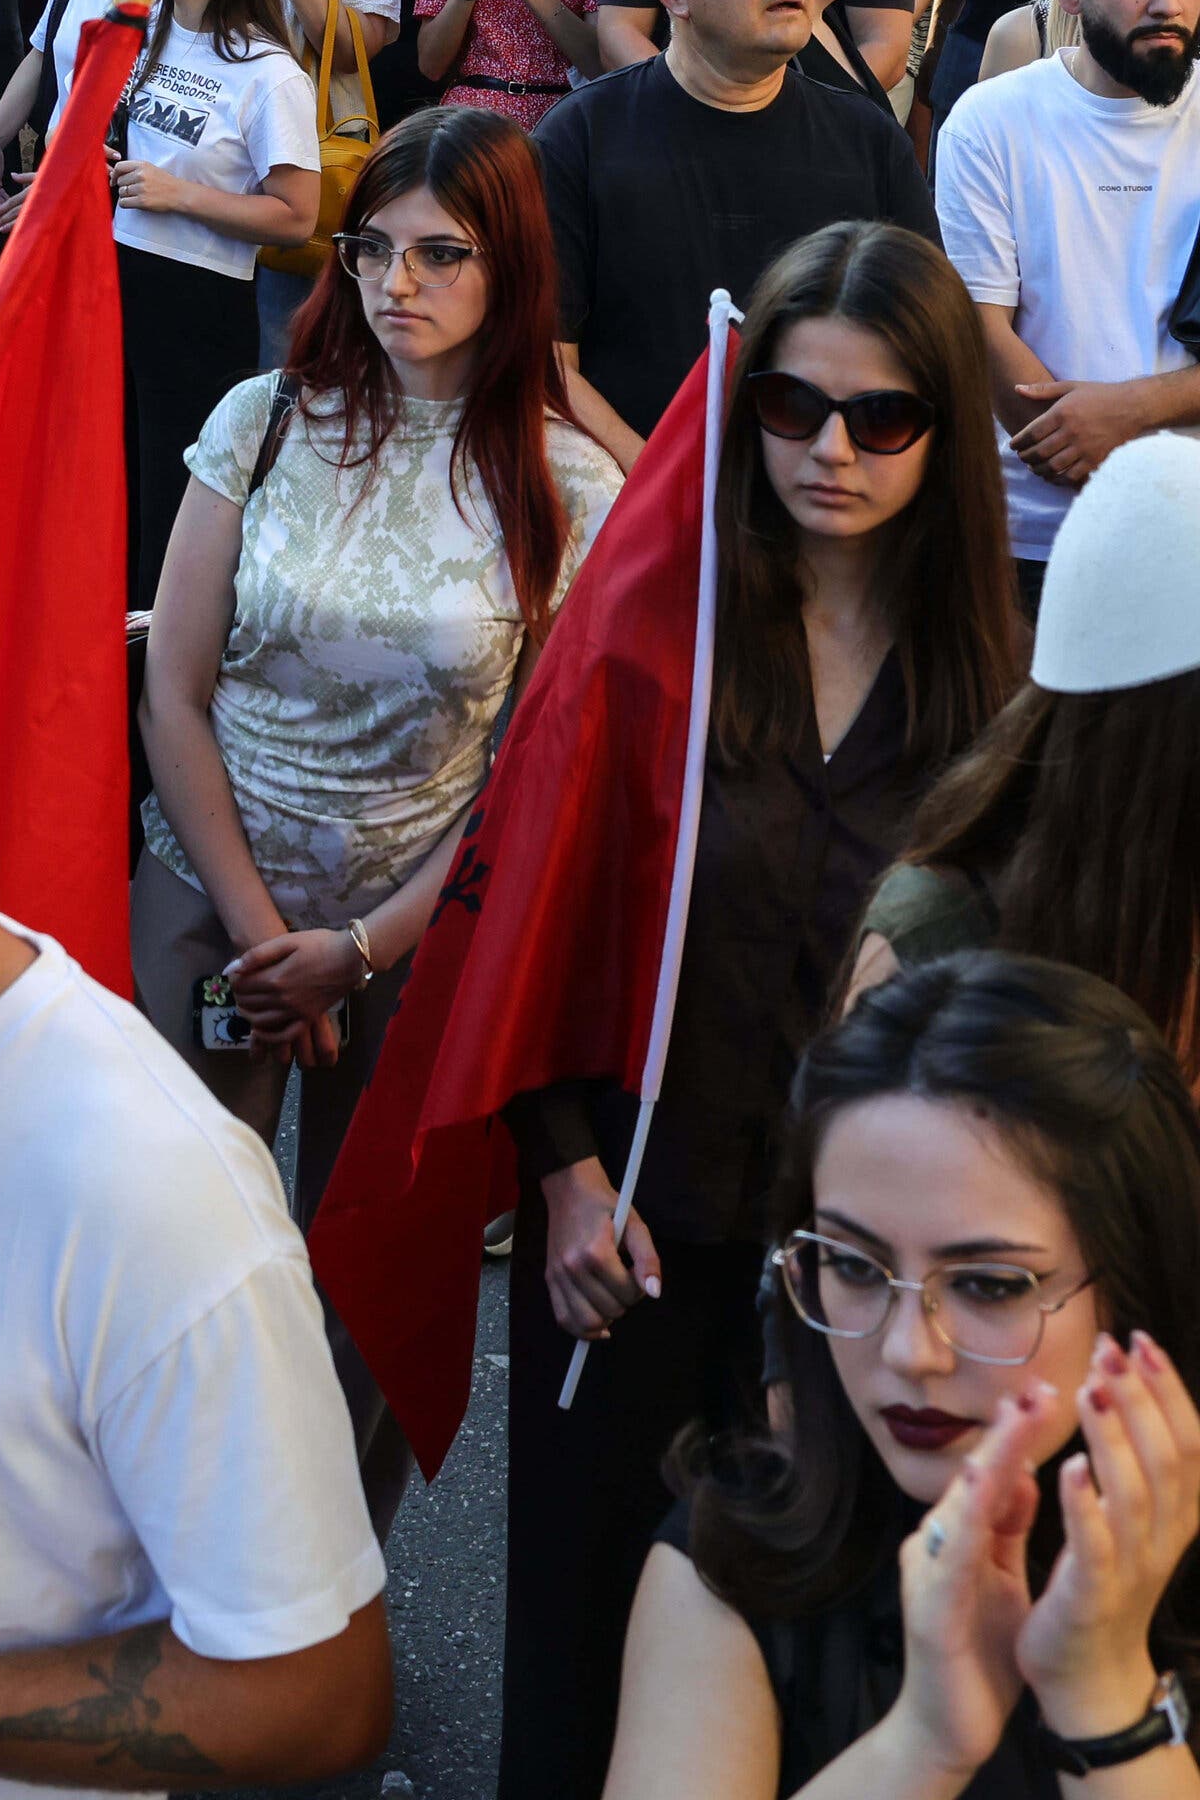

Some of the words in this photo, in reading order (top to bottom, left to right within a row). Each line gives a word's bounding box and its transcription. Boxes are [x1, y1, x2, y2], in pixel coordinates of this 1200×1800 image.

[157, 77, 171, 89] TO
[170, 81, 217, 104] become.
[178, 69, 191, 82] SO
[191, 73, 222, 93] MUCH
